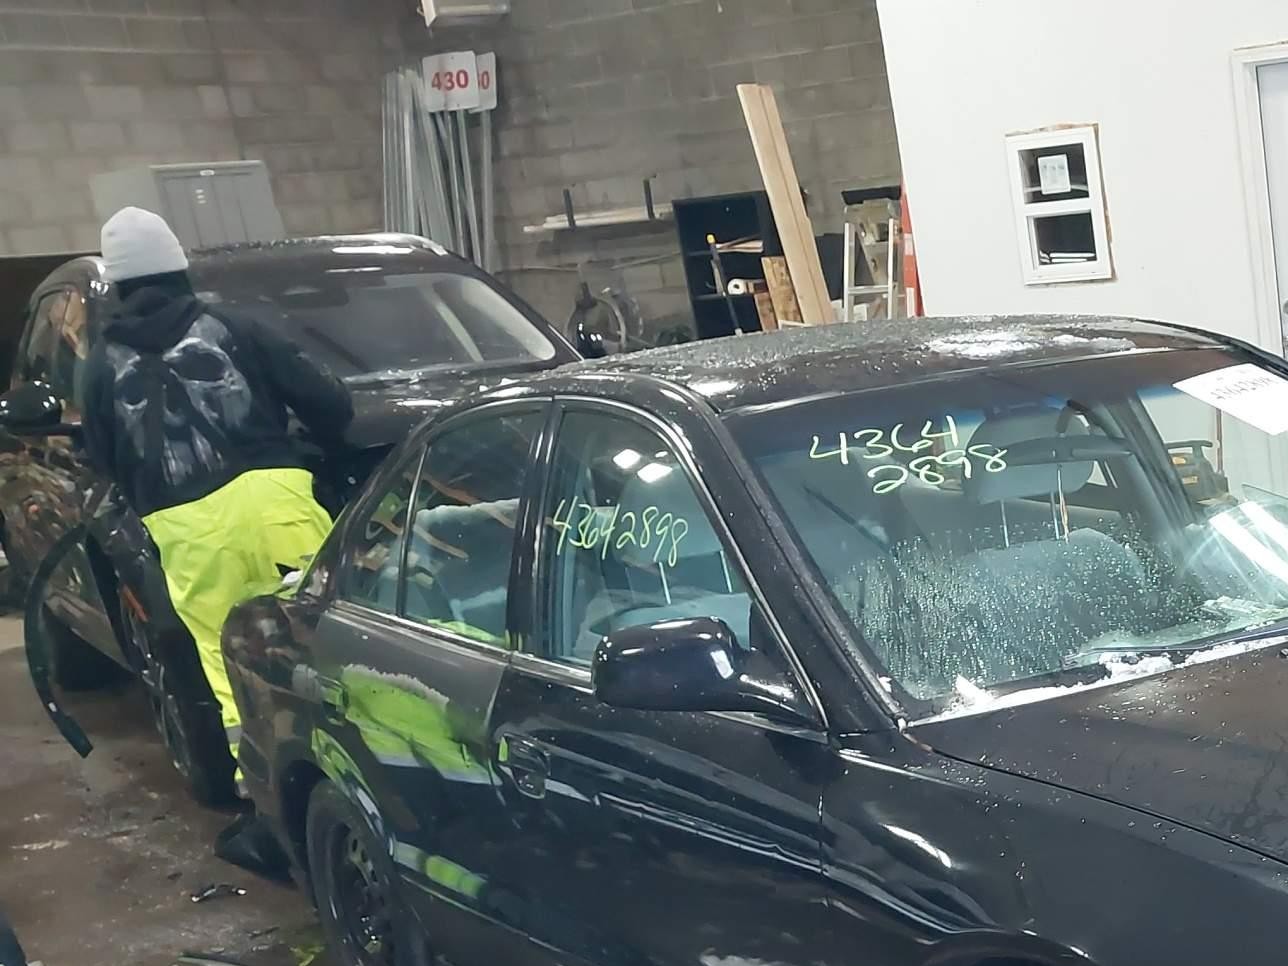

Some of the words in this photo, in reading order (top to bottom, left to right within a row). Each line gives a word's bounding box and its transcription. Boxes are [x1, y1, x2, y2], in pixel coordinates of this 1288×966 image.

[431, 69, 470, 92] 430
[809, 415, 959, 465] 4364
[867, 444, 1008, 494] 2898
[552, 495, 689, 567] 43642898
